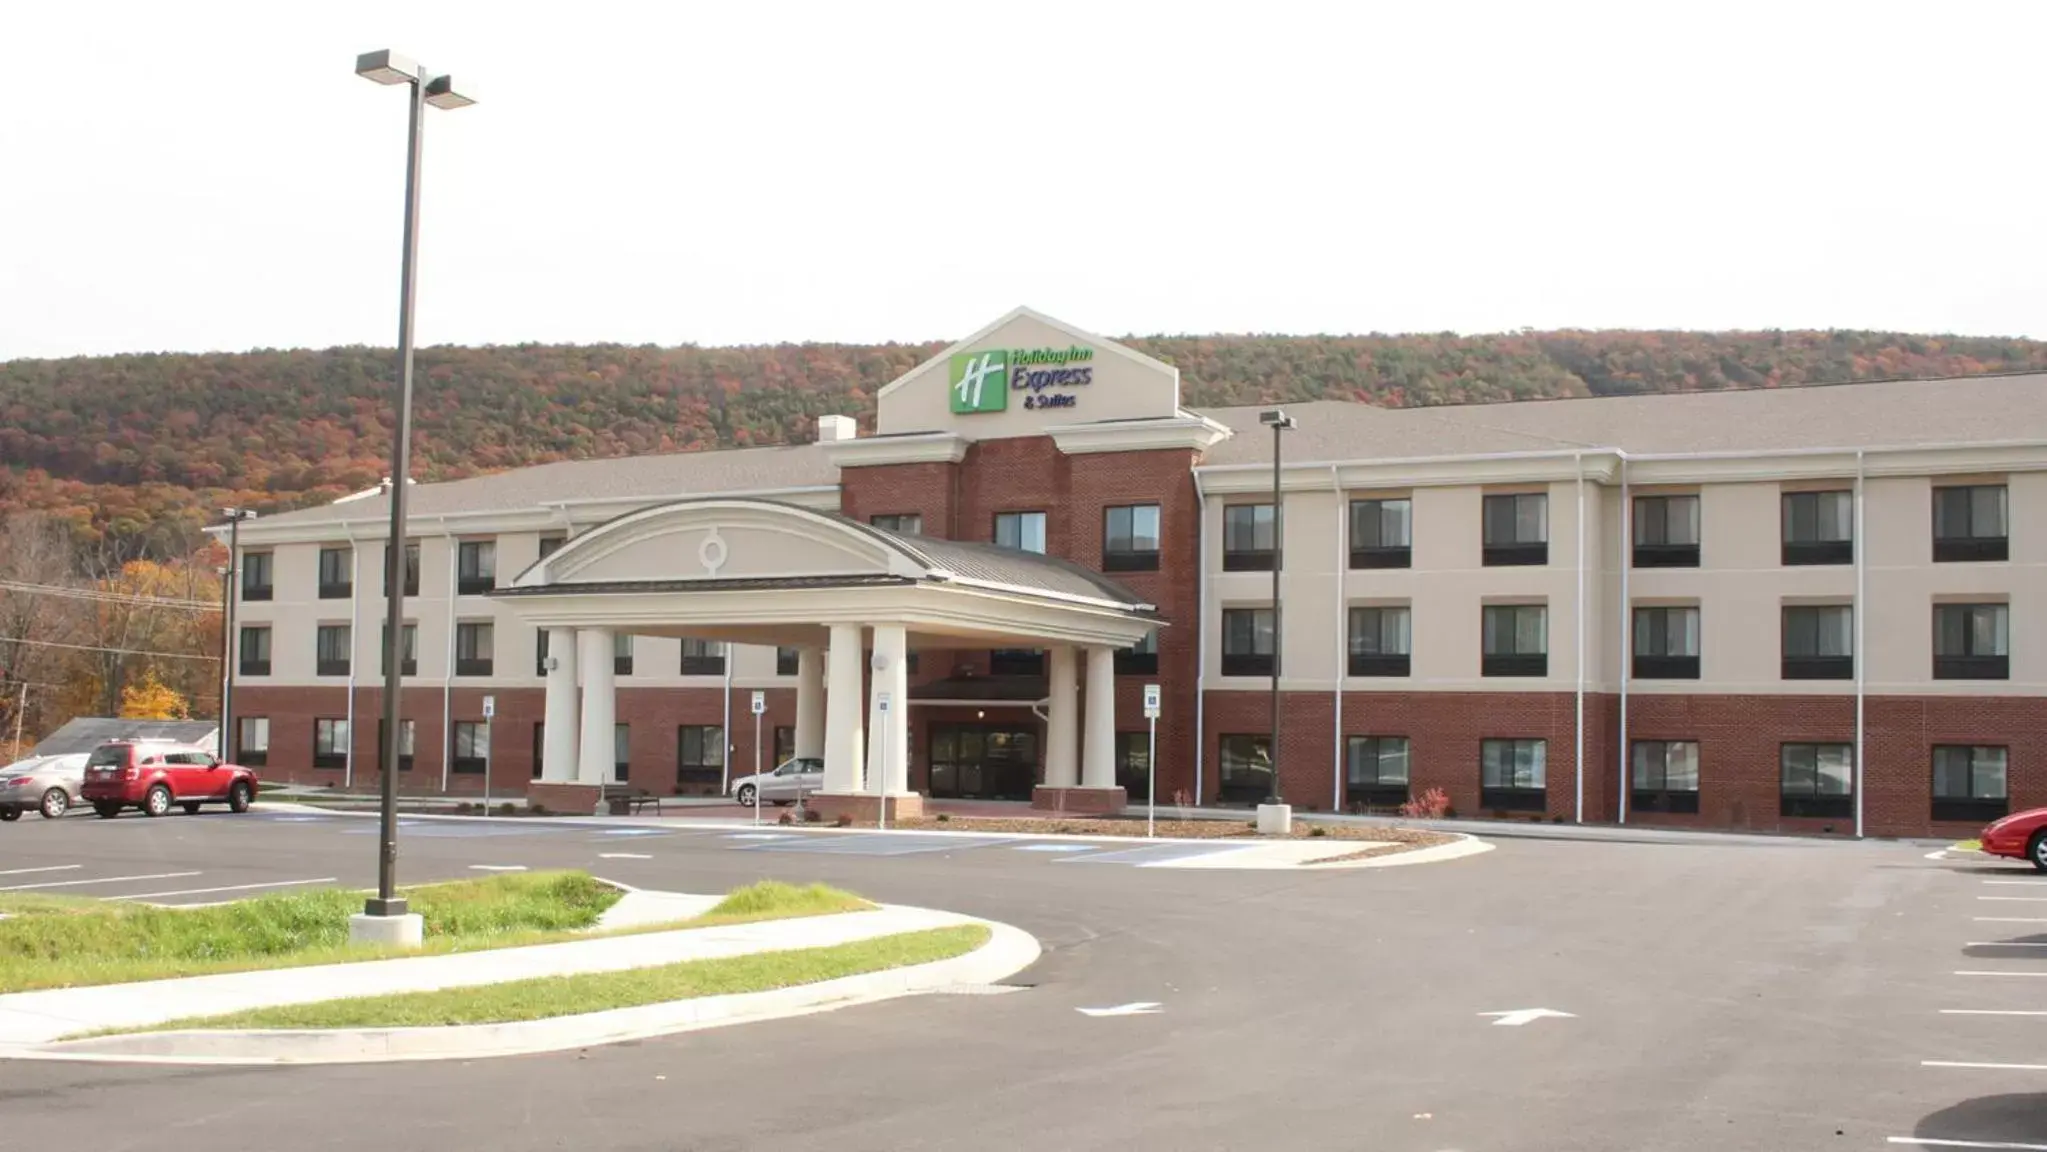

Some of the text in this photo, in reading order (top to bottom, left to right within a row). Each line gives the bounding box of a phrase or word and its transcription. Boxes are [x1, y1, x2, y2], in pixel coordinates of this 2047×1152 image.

[1012, 367, 1092, 392] Express
[1024, 394, 1076, 409] & Suites
